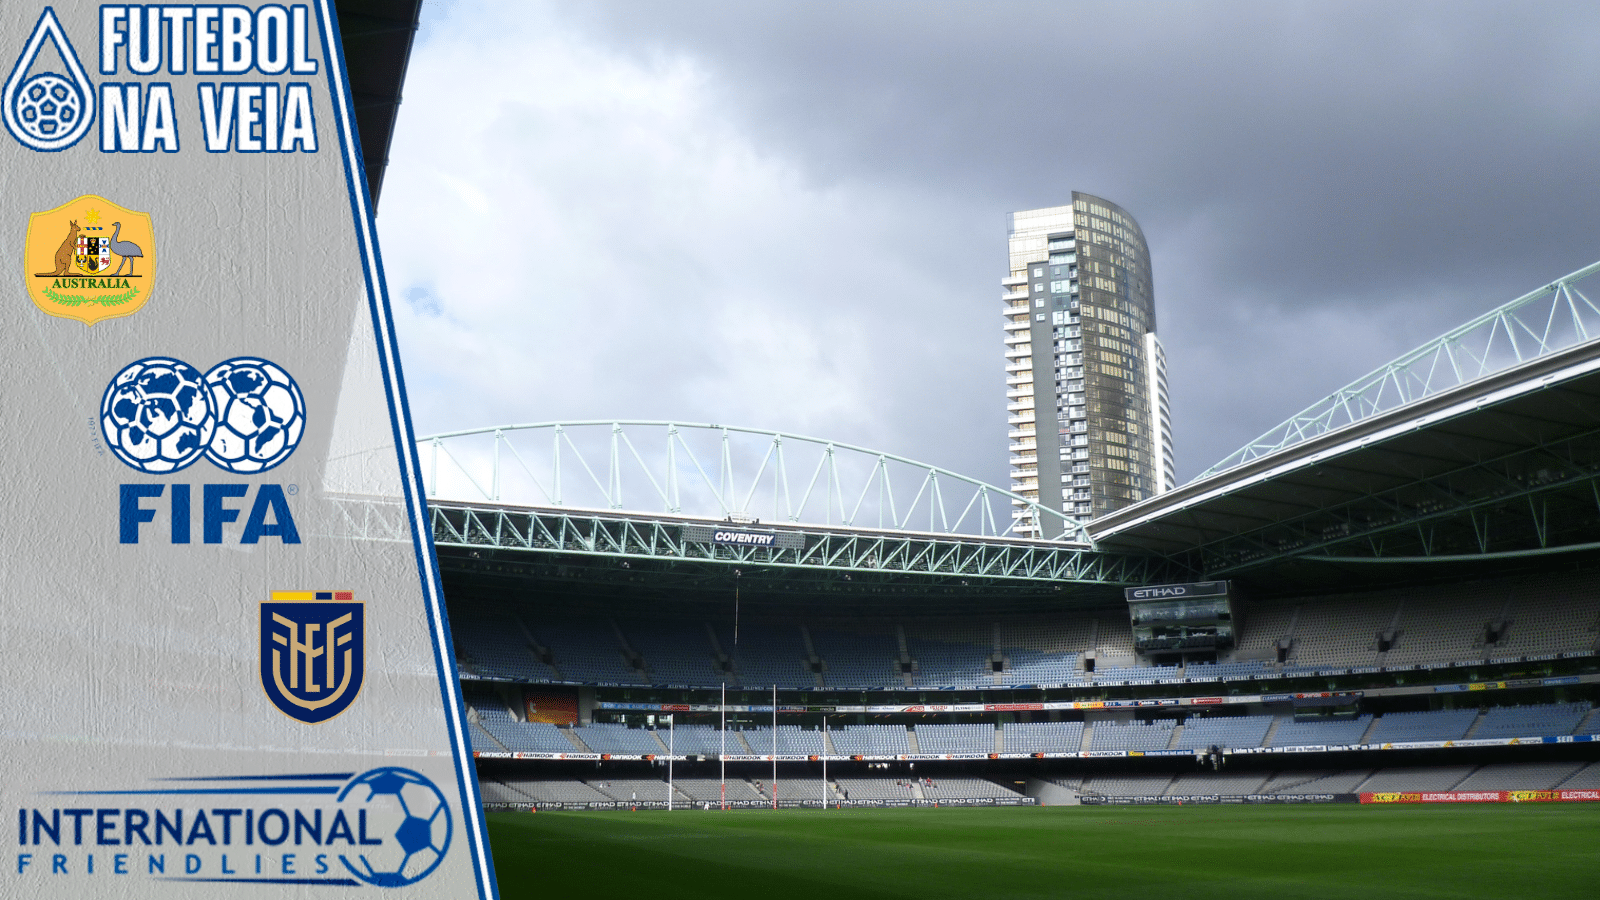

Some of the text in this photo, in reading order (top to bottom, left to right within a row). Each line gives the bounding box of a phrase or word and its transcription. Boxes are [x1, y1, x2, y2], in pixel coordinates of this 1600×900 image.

[715, 532, 774, 544] COVENTRY
[1134, 587, 1186, 598] ETIHAD
[1422, 793, 1456, 801] ELECTRICAL
[1457, 793, 1499, 801] DISTRIBUTORS
[1561, 791, 1600, 799] ELECTRICAL
